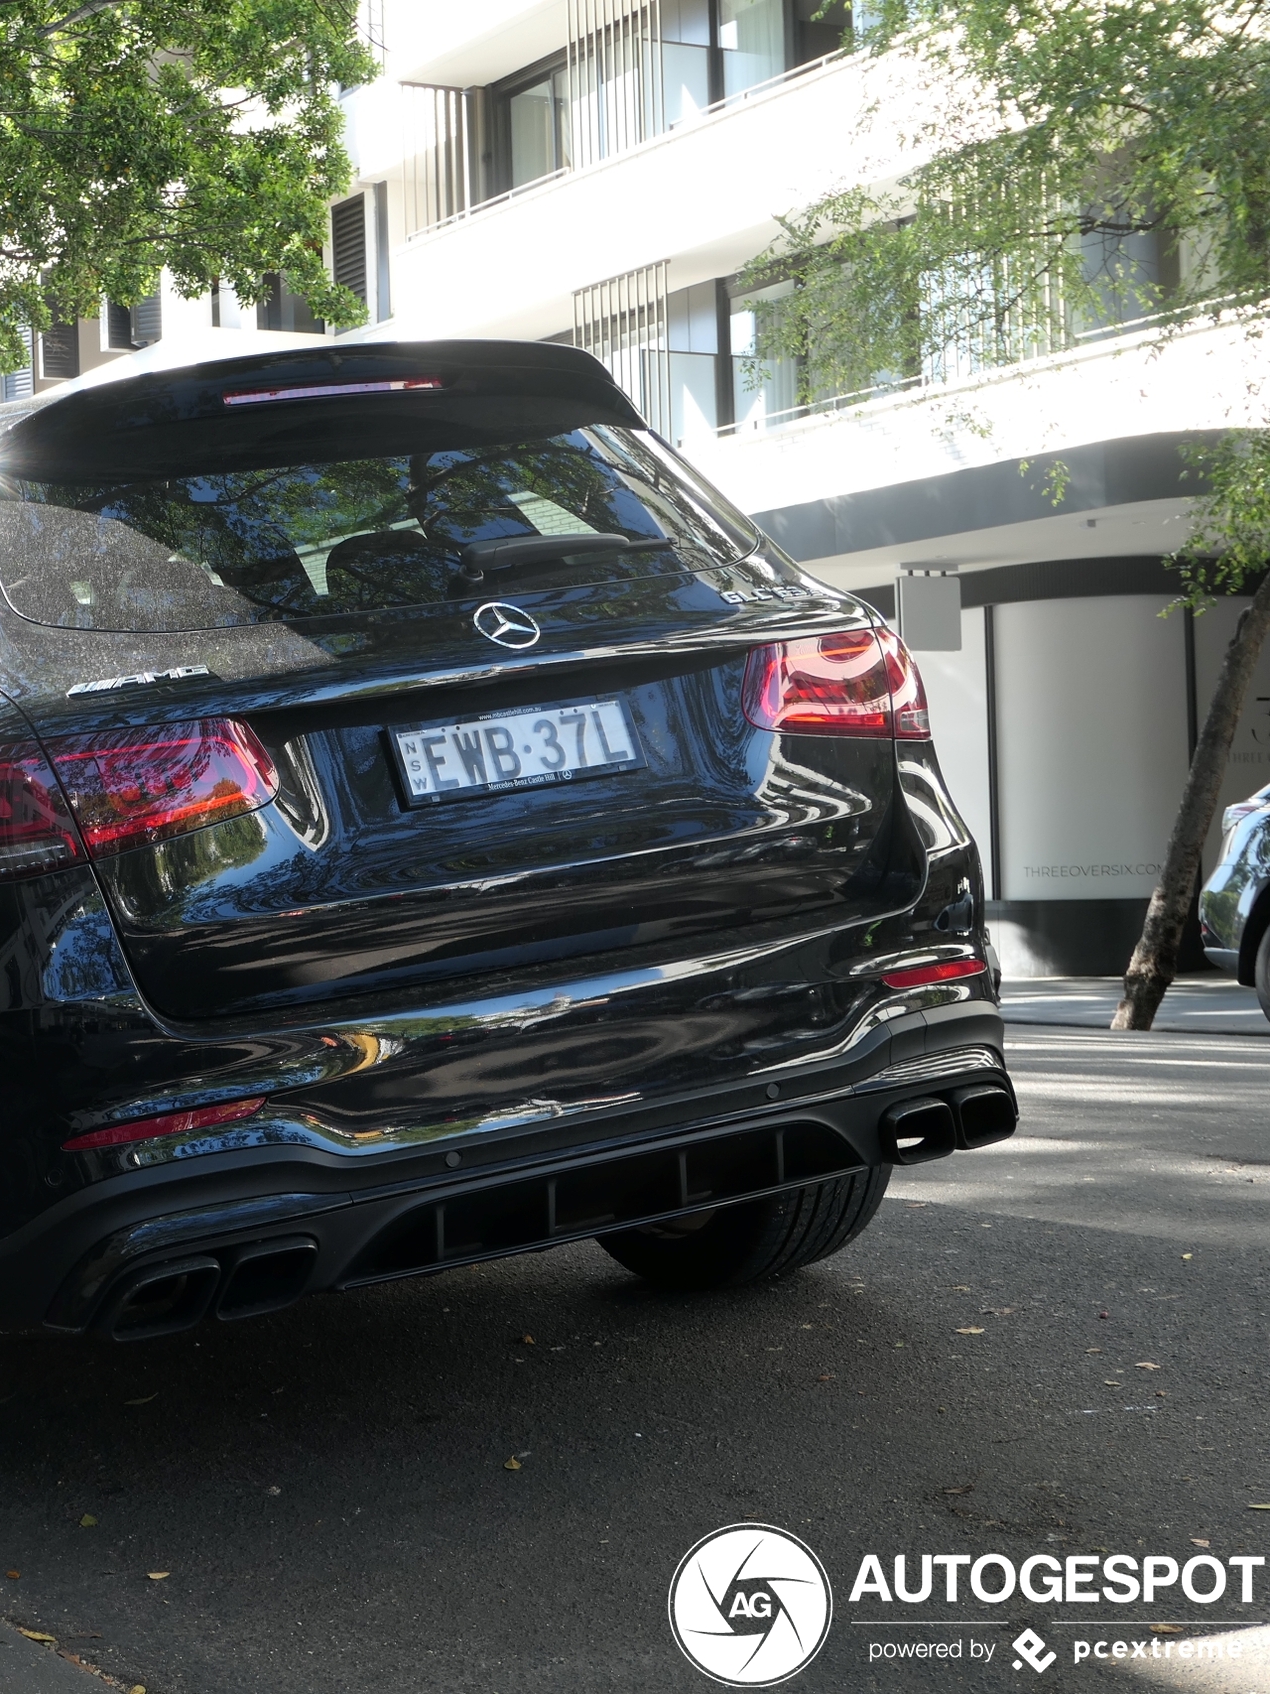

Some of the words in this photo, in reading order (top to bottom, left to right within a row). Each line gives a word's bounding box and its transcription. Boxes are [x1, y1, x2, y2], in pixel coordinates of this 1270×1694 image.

[720, 587, 773, 605] GLC
[487, 779, 528, 791] Mercedes-Benz
[527, 776, 545, 785] Castle
[545, 773, 556, 781] Hill
